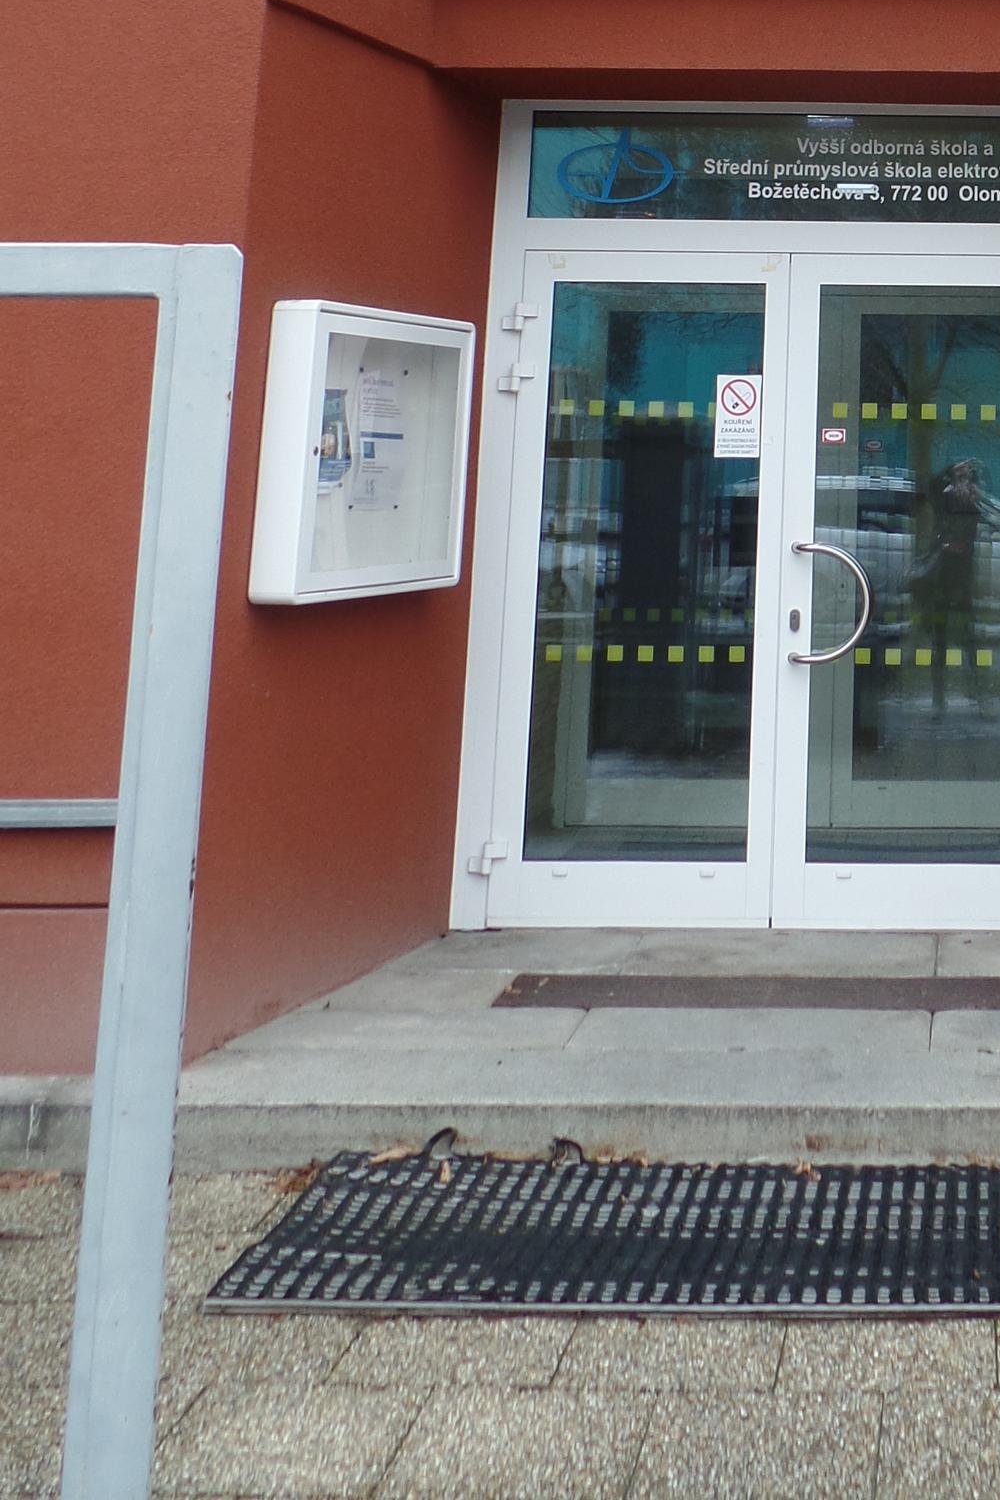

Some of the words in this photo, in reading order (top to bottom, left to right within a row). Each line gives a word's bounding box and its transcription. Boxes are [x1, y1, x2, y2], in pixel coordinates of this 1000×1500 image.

[797, 137, 845, 157] Vyšší
[850, 139, 925, 156] odborná
[930, 140, 978, 156] škola
[983, 143, 994, 156] a
[703, 158, 768, 175] Střední
[773, 157, 879, 180] průmyslová
[884, 161, 932, 178] škola
[891, 185, 922, 201] 772
[927, 185, 949, 201] 00
